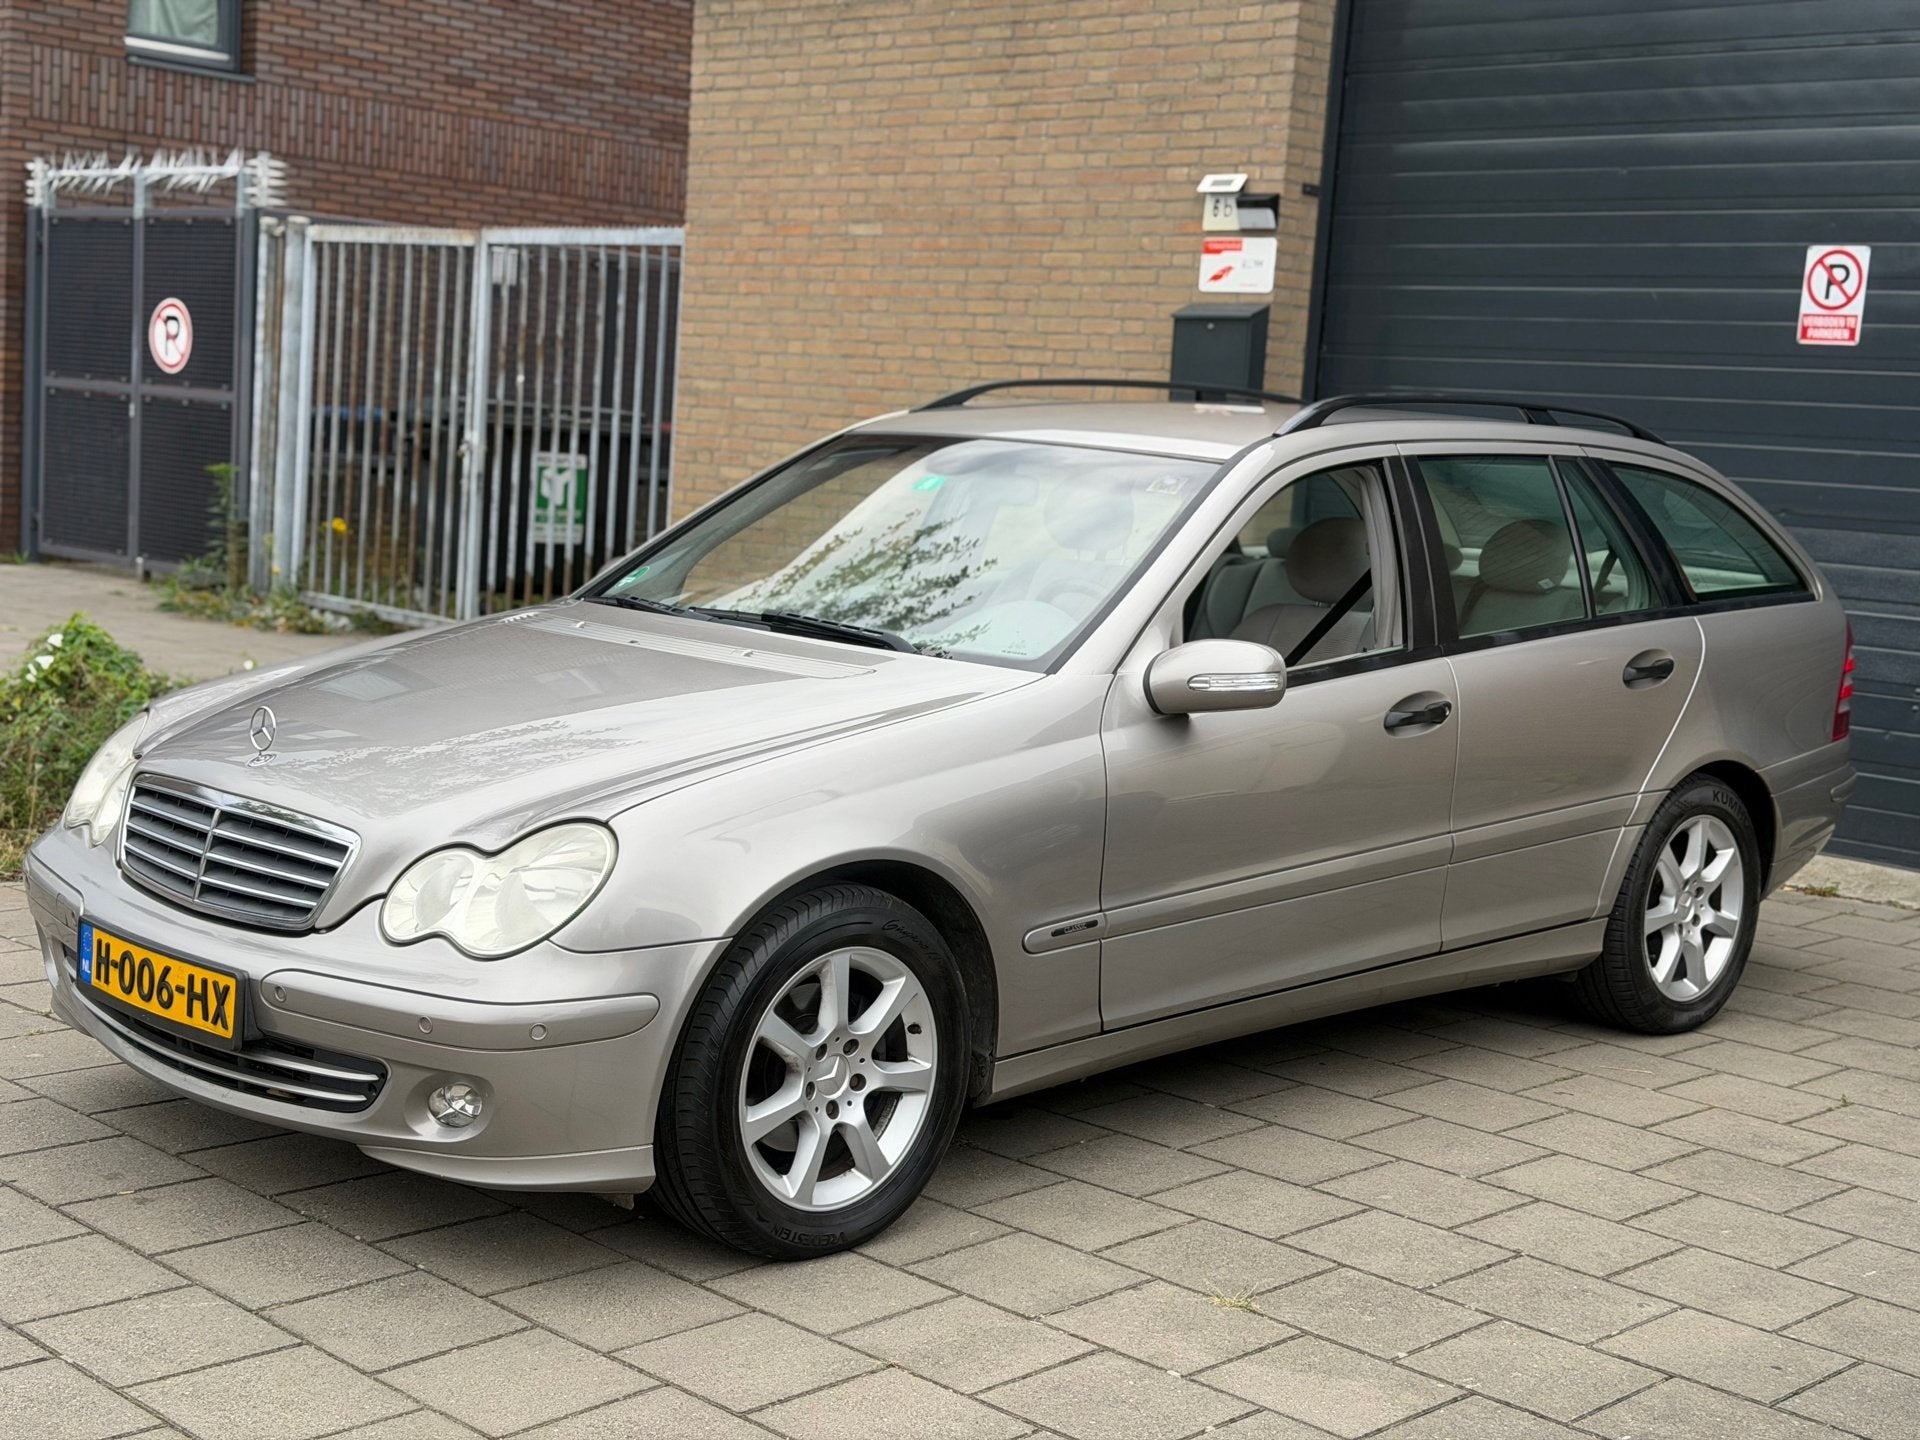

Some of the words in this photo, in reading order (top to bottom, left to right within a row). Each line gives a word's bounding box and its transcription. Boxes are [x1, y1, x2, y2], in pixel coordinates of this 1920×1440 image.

[1825, 264, 1850, 300] P
[164, 316, 180, 356] P
[1712, 789, 1752, 828] KUMHO
[1063, 922, 1087, 934] CLASSIC
[81, 958, 91, 974] NL
[95, 937, 231, 1031] H-006-HX
